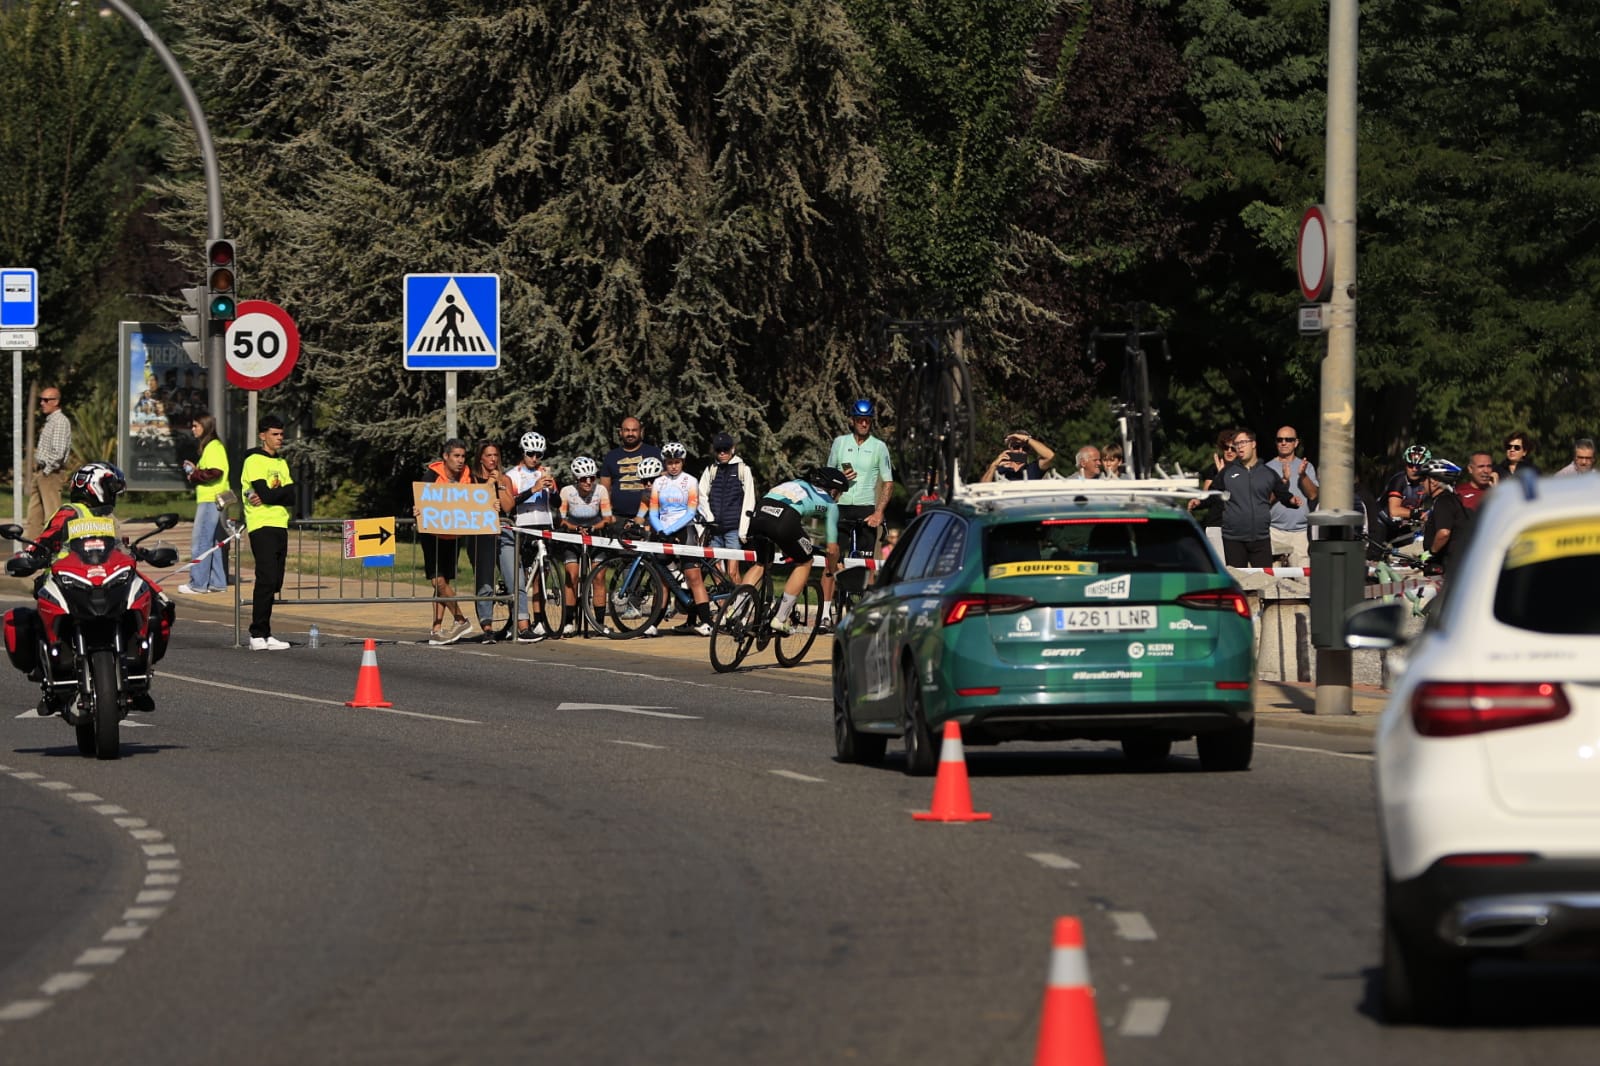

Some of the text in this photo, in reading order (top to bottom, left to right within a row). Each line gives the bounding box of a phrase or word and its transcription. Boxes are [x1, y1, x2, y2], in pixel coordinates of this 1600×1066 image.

[233, 331, 280, 359] 50
[420, 484, 490, 504] ÁNIMO
[422, 507, 498, 532] ROBER
[1016, 563, 1071, 572] EQUIPOS
[1086, 579, 1127, 597] FINISHER
[1068, 610, 1151, 627] 4261 LNR
[1041, 648, 1086, 657] GIANT
